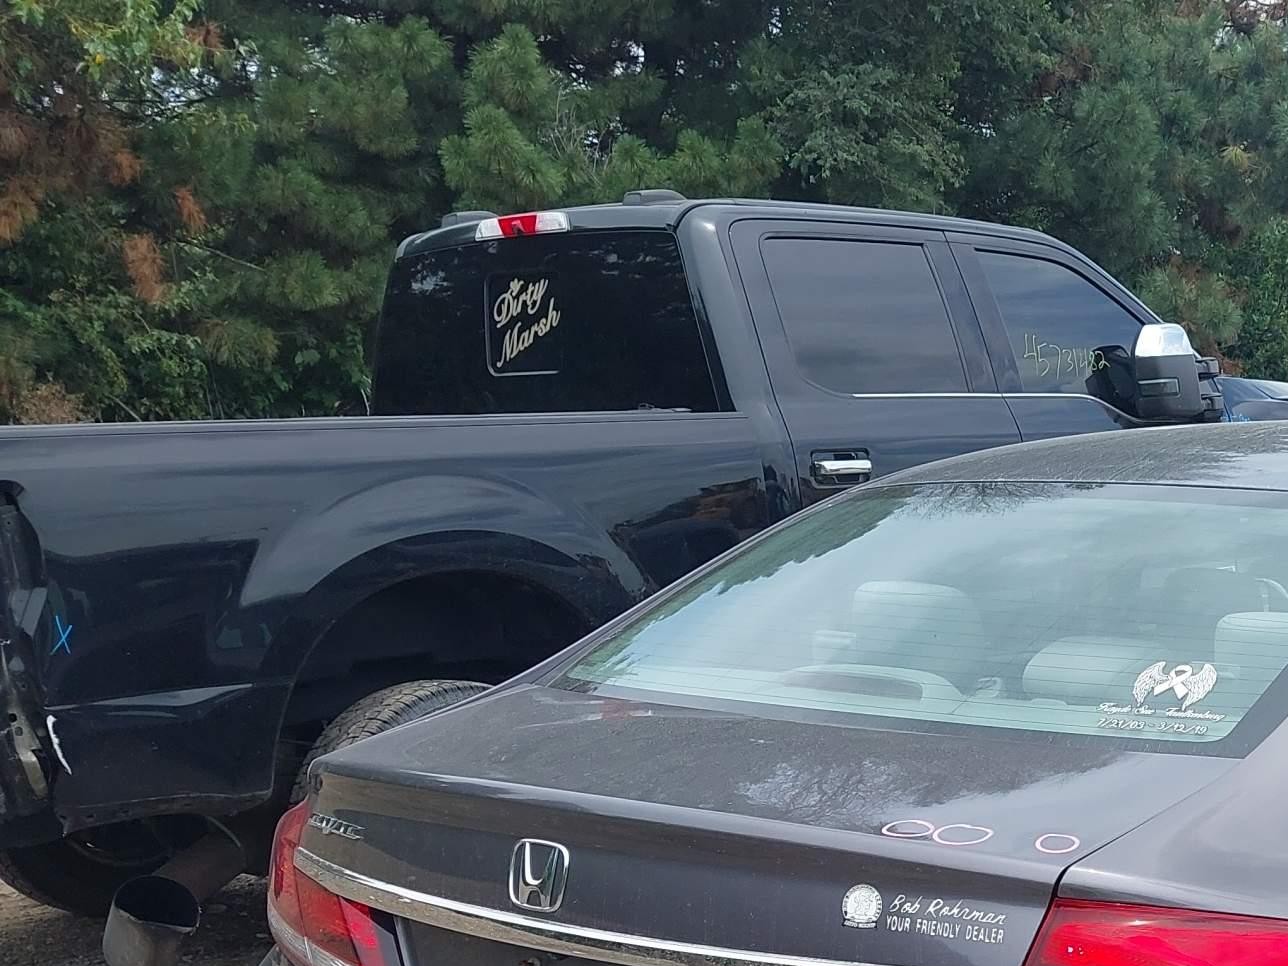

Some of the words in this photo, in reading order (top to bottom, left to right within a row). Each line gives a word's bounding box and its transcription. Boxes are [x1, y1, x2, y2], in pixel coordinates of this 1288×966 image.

[494, 278, 548, 328] Dirty
[496, 297, 561, 367] Marsh
[1023, 332, 1111, 380] 45731482
[889, 894, 923, 913] Bob
[886, 914, 911, 933] YOUR
[915, 918, 961, 939] FRIENDLY
[965, 924, 1005, 944] DEALER
